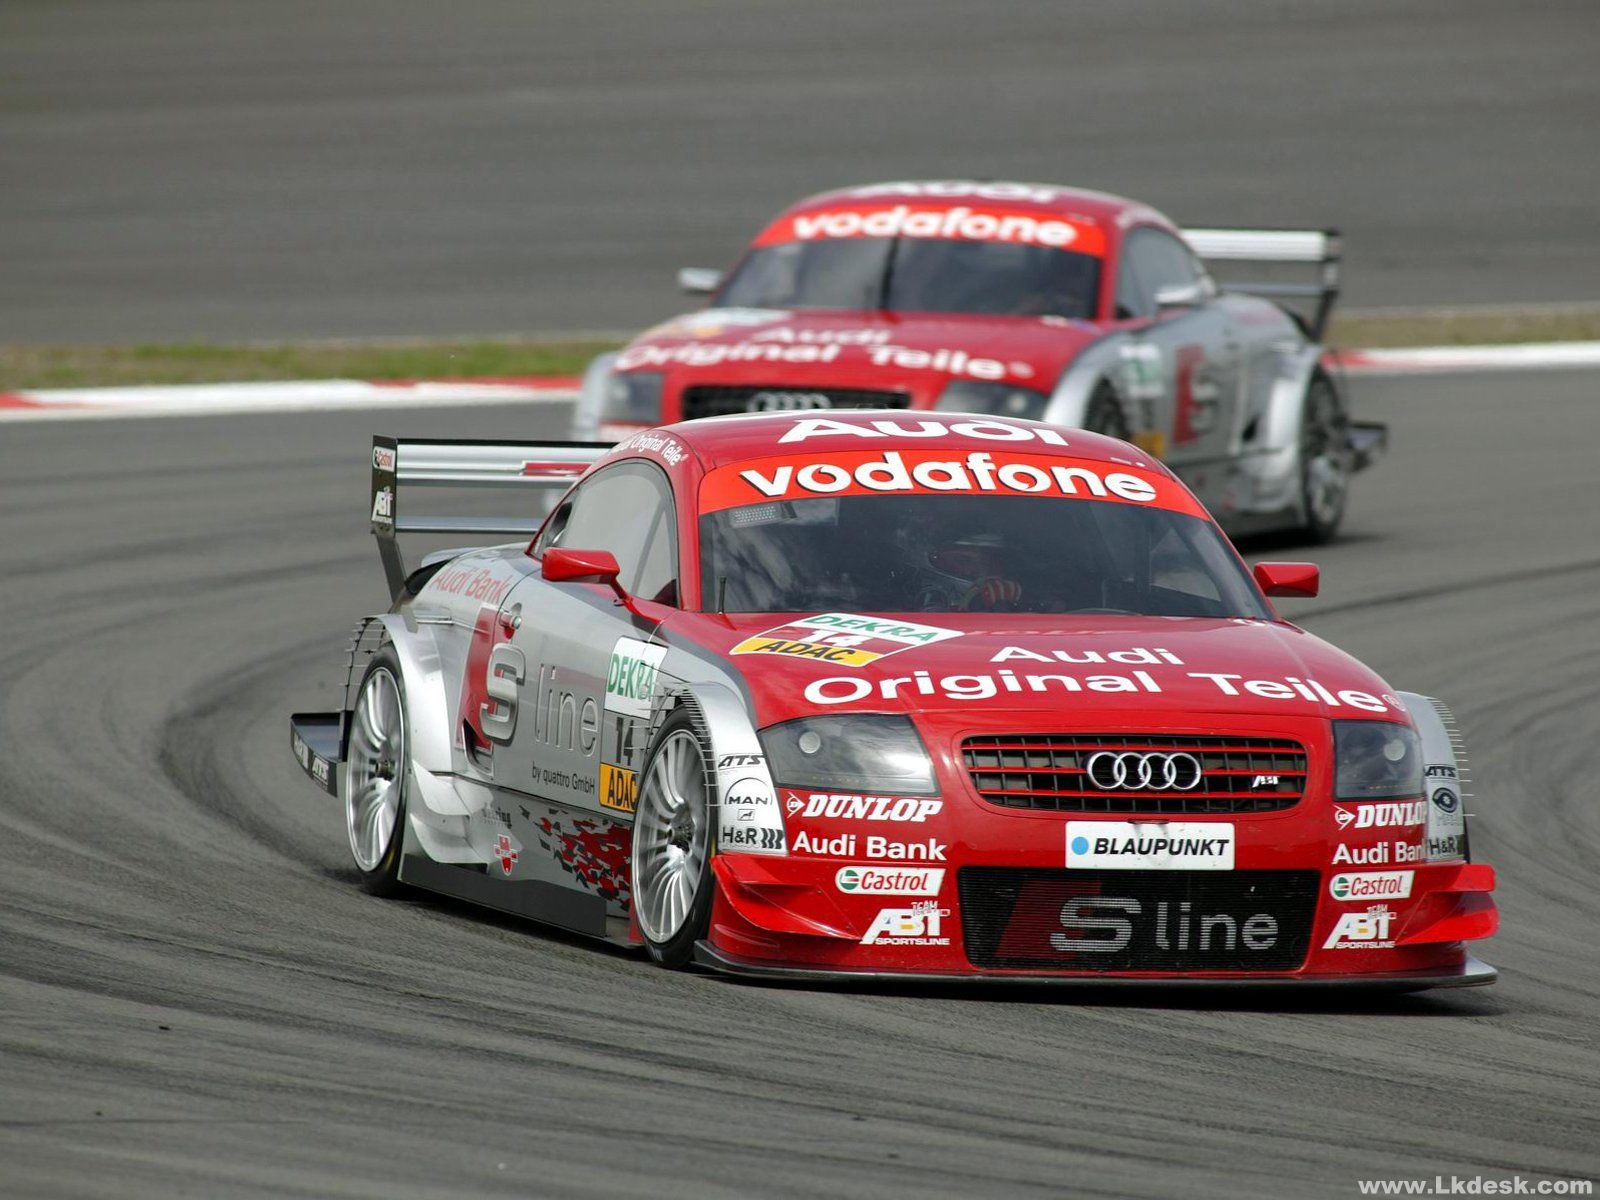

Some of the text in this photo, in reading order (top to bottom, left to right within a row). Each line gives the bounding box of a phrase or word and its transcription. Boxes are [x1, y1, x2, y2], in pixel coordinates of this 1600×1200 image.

[793, 206, 1078, 247] vodafone
[753, 327, 891, 345] Audi
[614, 343, 841, 371] Original
[777, 418, 1069, 446] Audi
[740, 451, 1158, 501] vodafone
[802, 614, 939, 642] DEKRA
[753, 640, 855, 661] ADAC
[990, 646, 1185, 665] Audi
[479, 642, 599, 758] S line
[804, 670, 1163, 705] Original
[615, 717, 634, 766] 14
[718, 755, 767, 768] ATS
[1425, 765, 1457, 777] ATS
[531, 761, 595, 794] by quattro GmbH
[607, 768, 639, 811] ADAC
[728, 796, 768, 805] MAN
[802, 794, 943, 822] DUNLOP
[722, 826, 757, 844] H&R
[792, 831, 947, 861] Audi Bank
[1093, 838, 1230, 857] BLAUPUNKT
[1429, 836, 1456, 854] H&R
[1331, 841, 1388, 864] Audi
[861, 871, 928, 891] Castrol
[1351, 875, 1403, 896] Castrol
[859, 908, 950, 945] ABT
[1050, 897, 1279, 953] S line
[1322, 912, 1397, 949] ABT
[874, 937, 950, 945] SPORTSLINE
